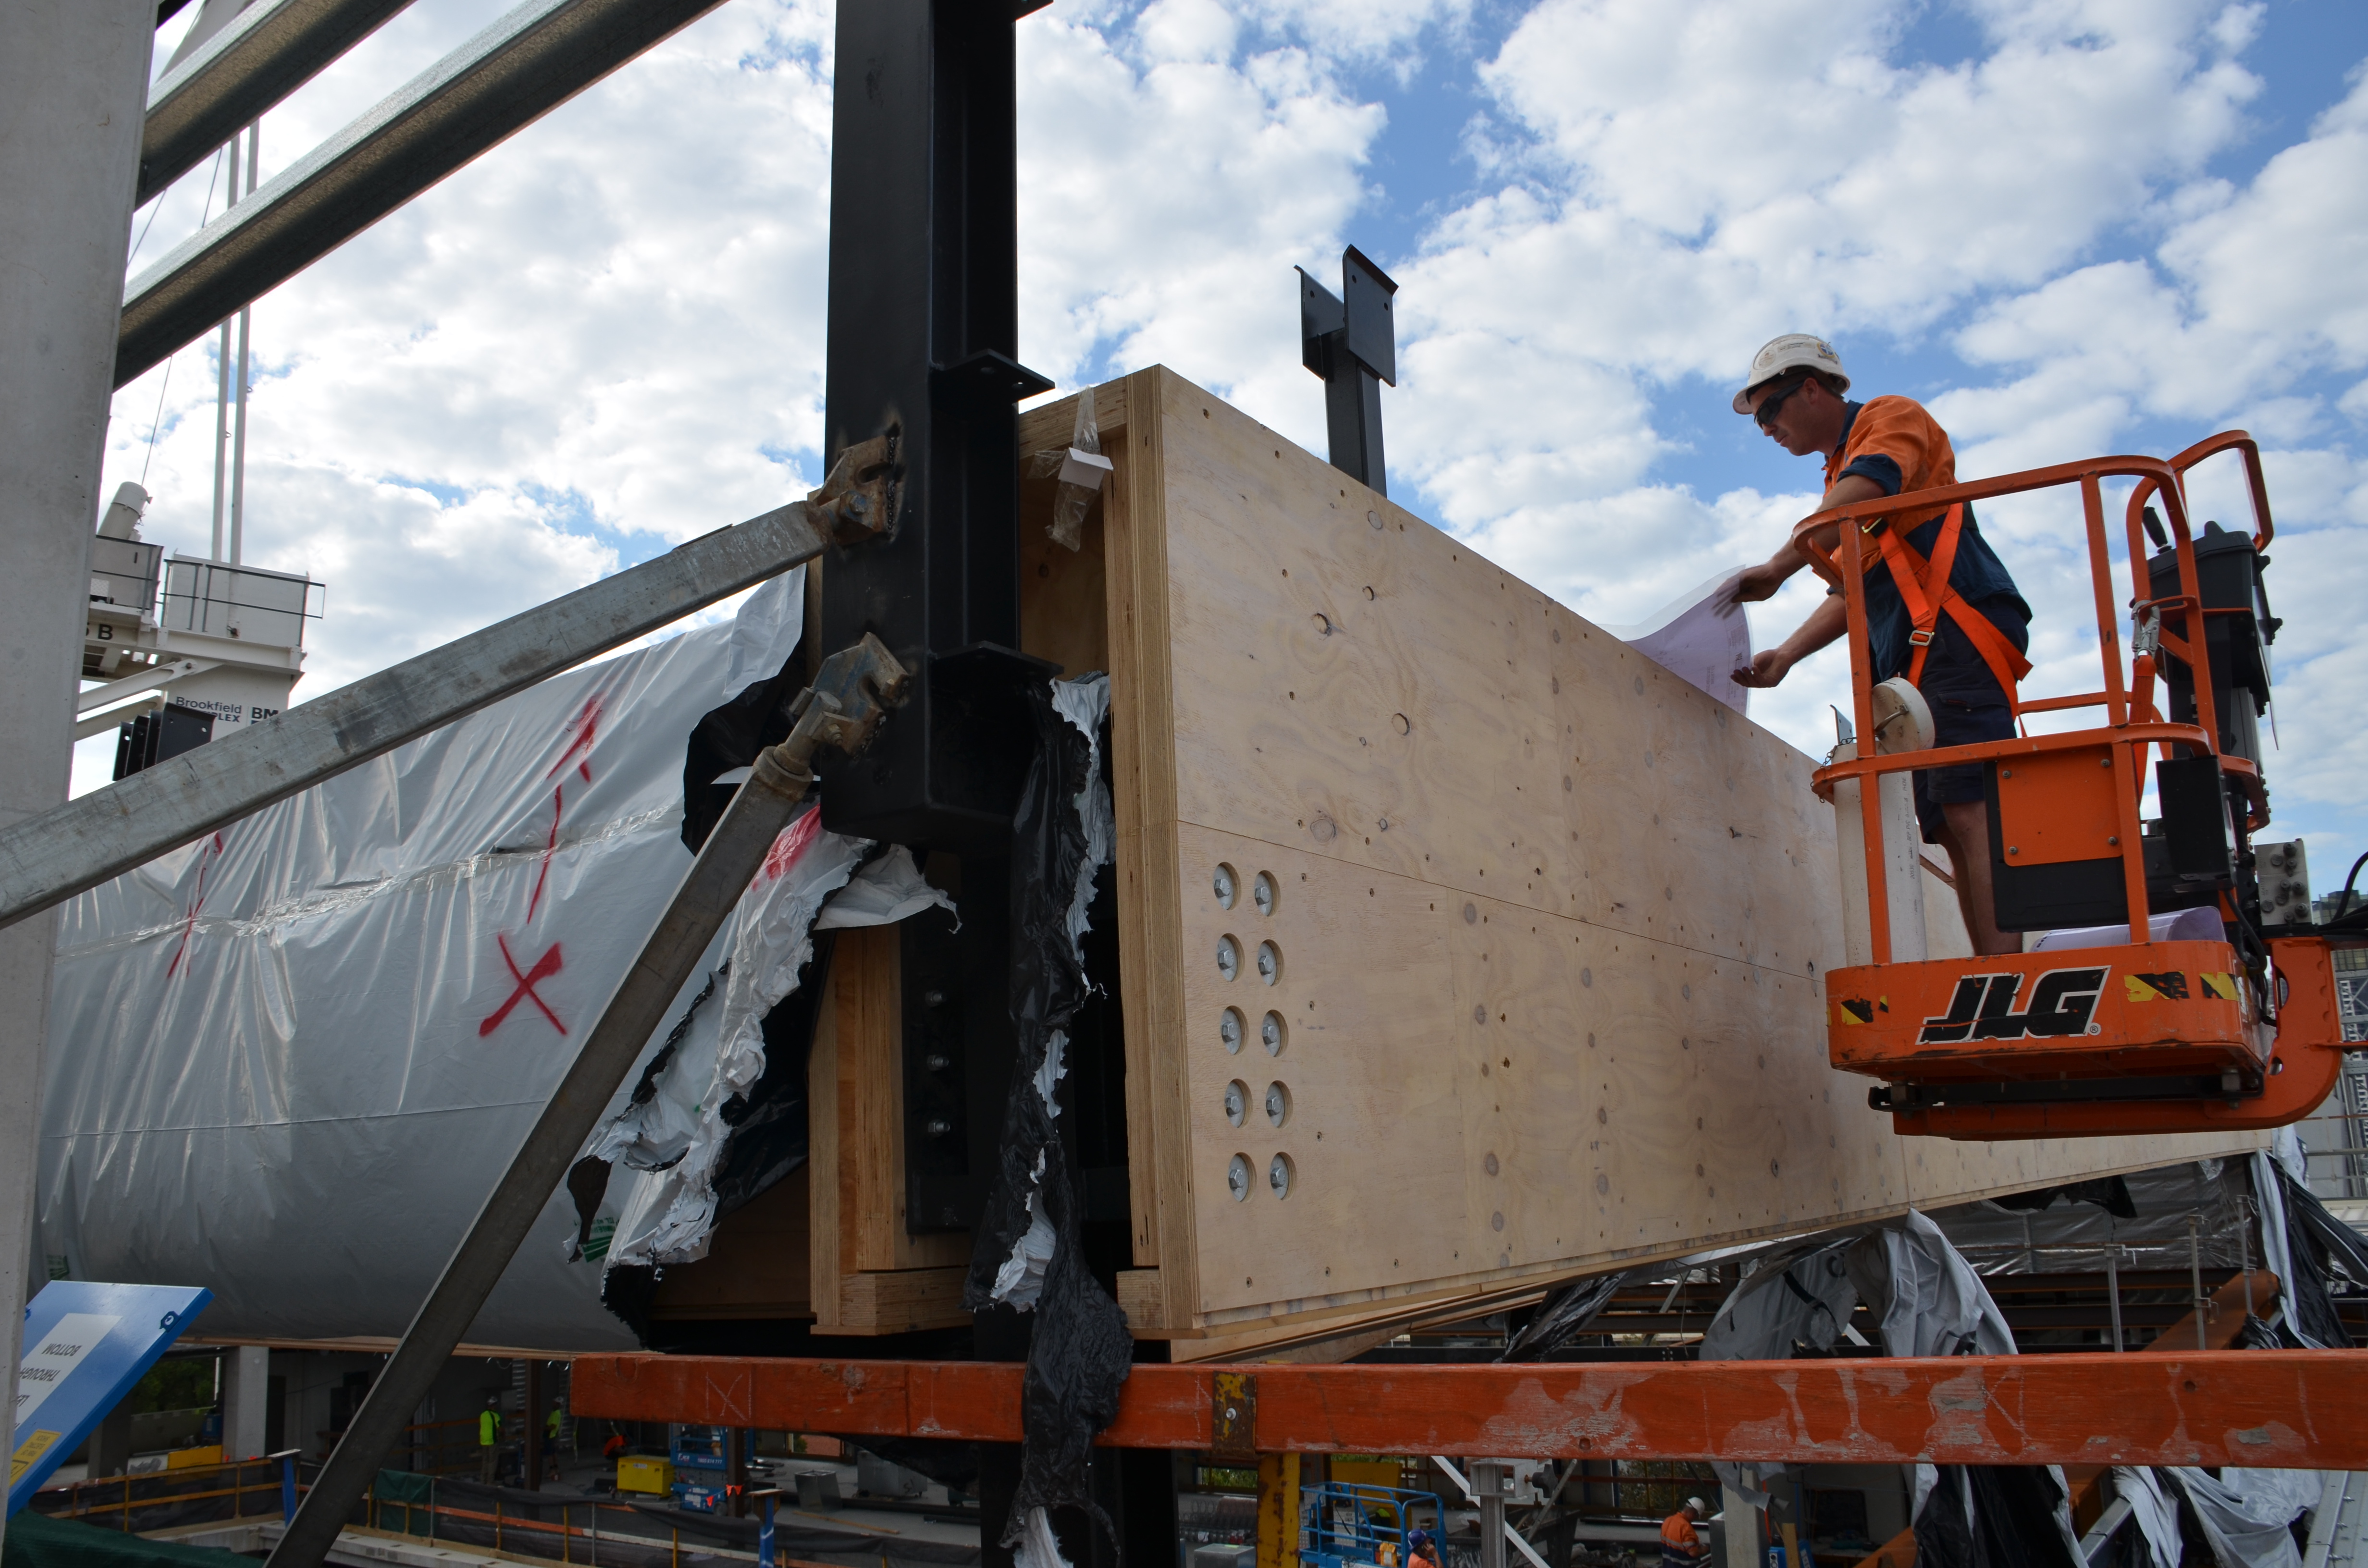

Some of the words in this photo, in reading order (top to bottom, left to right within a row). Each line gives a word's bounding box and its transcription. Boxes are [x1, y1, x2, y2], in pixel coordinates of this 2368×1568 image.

[175, 696, 242, 714] Brookfield
[1916, 965, 2111, 1045] JLG
[41, 1343, 82, 1357] BOTTOM
